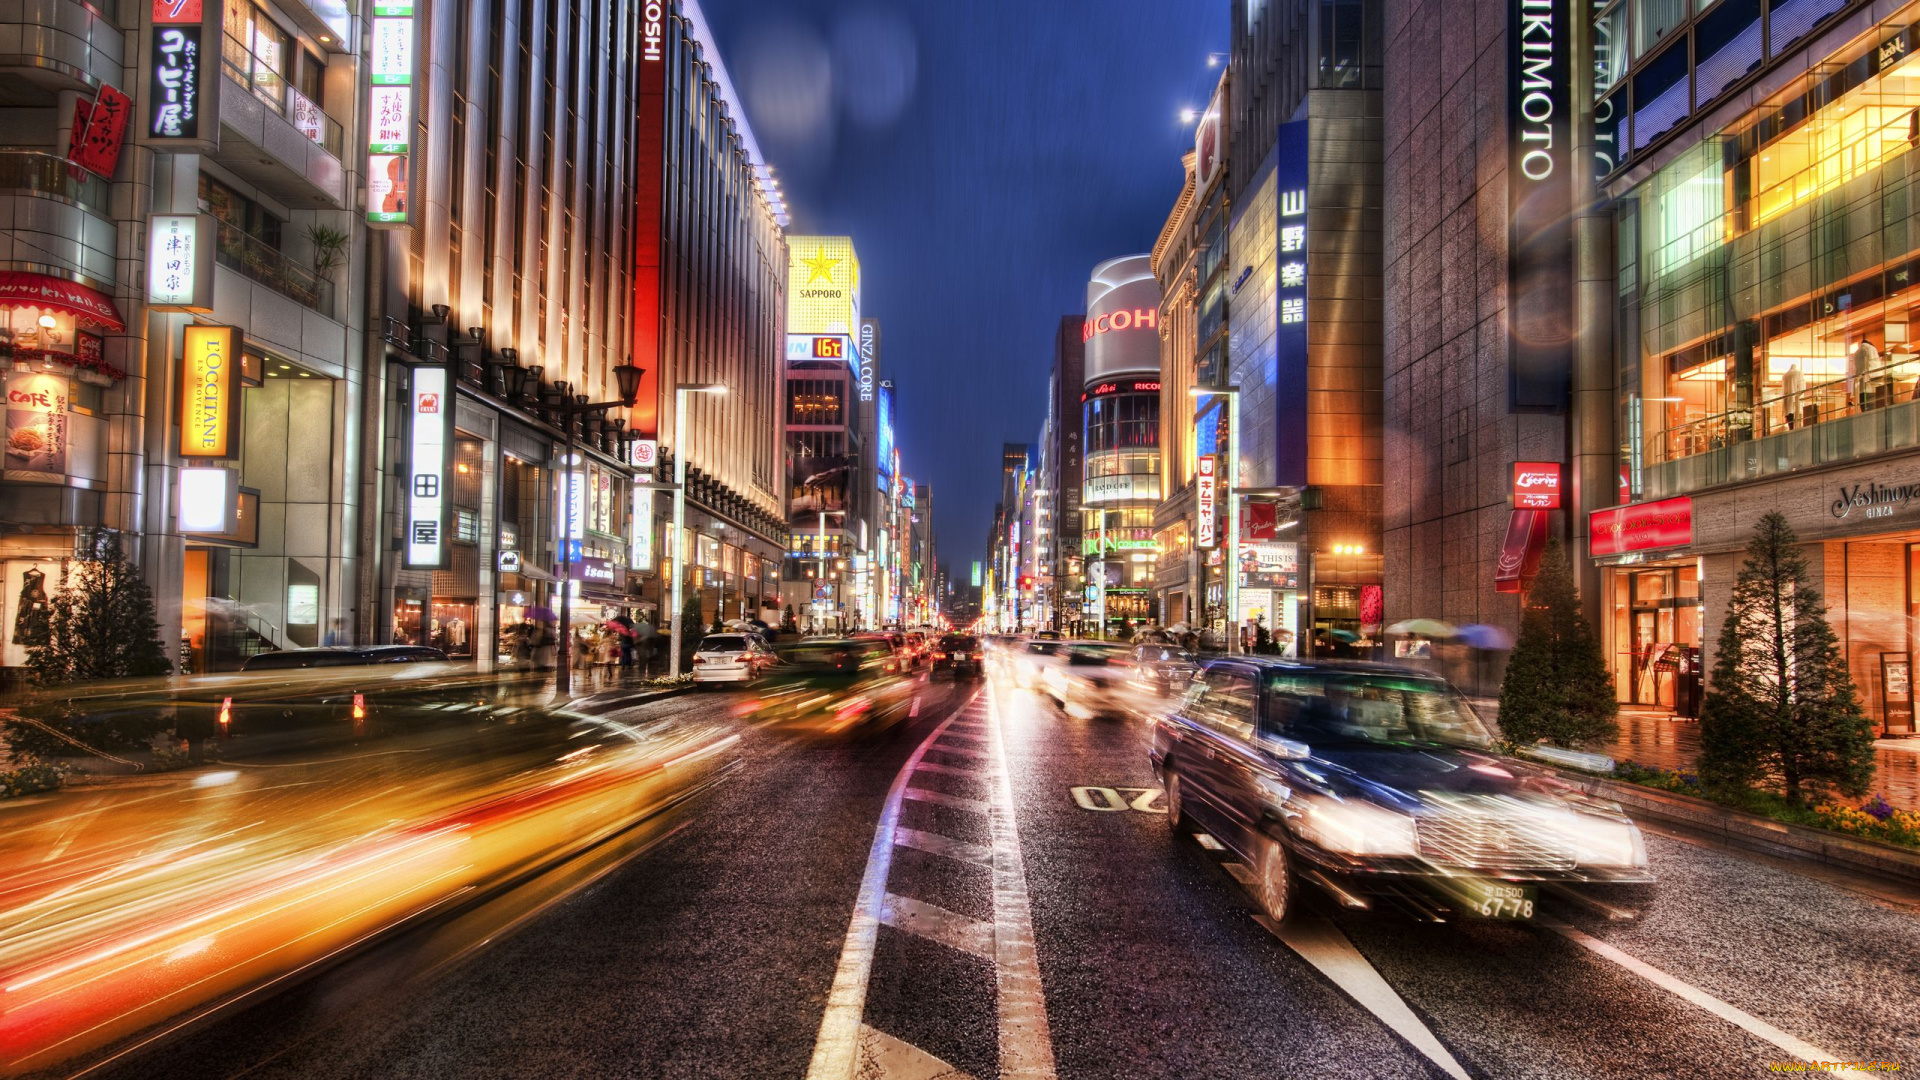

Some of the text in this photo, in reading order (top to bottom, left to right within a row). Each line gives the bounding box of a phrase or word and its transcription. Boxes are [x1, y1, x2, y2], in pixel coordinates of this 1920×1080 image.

[645, 0, 661, 60] OSHI
[155, 30, 184, 136] コーヒー屋
[380, 95, 391, 126] すみか
[392, 91, 402, 122] 天使の
[382, 144, 399, 152] 4F
[1281, 190, 1305, 324] 山野楽器
[800, 289, 841, 298] SAPPORO
[1083, 309, 1156, 343] RICOH
[861, 324, 873, 401] GINZA CORE
[195, 360, 203, 429] EN PROVENCE
[203, 341, 222, 448] L'OCCITANE
[412, 473, 439, 545] 田屋
[1201, 480, 1213, 543] キムラヤのパン
[1866, 505, 1893, 518] GINZA
[1251, 521, 1274, 535] Fender
[1482, 898, 1533, 918] 67-78
[1505, 888, 1523, 898] 500
